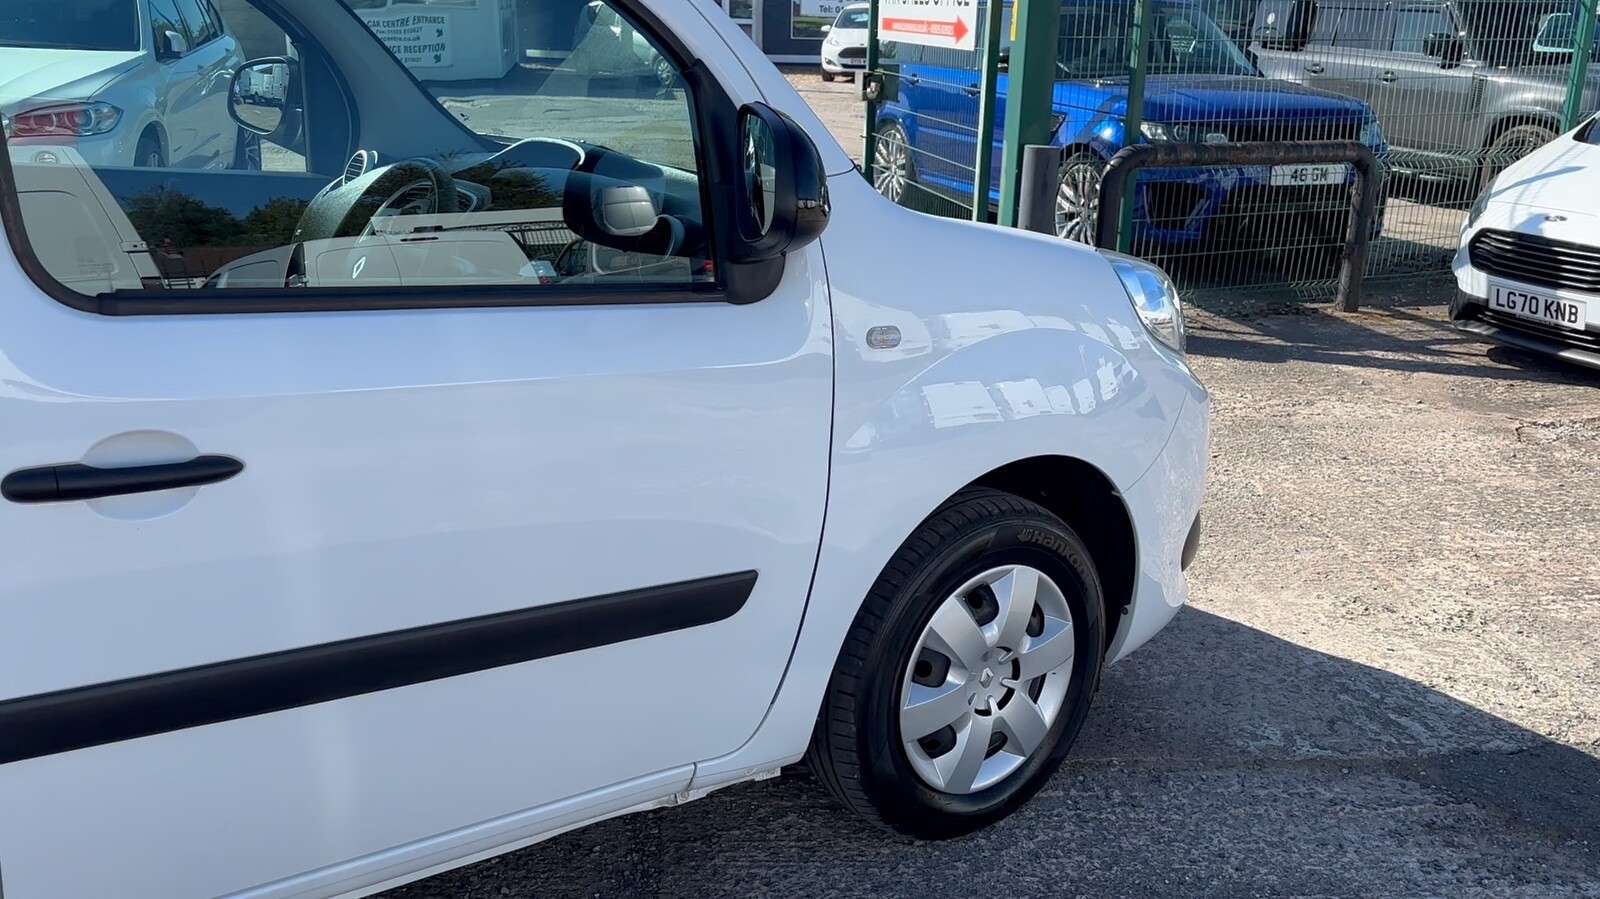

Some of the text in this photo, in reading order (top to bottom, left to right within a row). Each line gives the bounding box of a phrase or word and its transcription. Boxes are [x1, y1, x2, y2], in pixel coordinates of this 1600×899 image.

[819, 4, 833, 13] Tel:
[382, 17, 410, 28] CENTRE
[411, 15, 446, 26] ENTRANCE
[403, 43, 447, 54] RECEPTION
[1495, 288, 1579, 324] LG70 KNB
